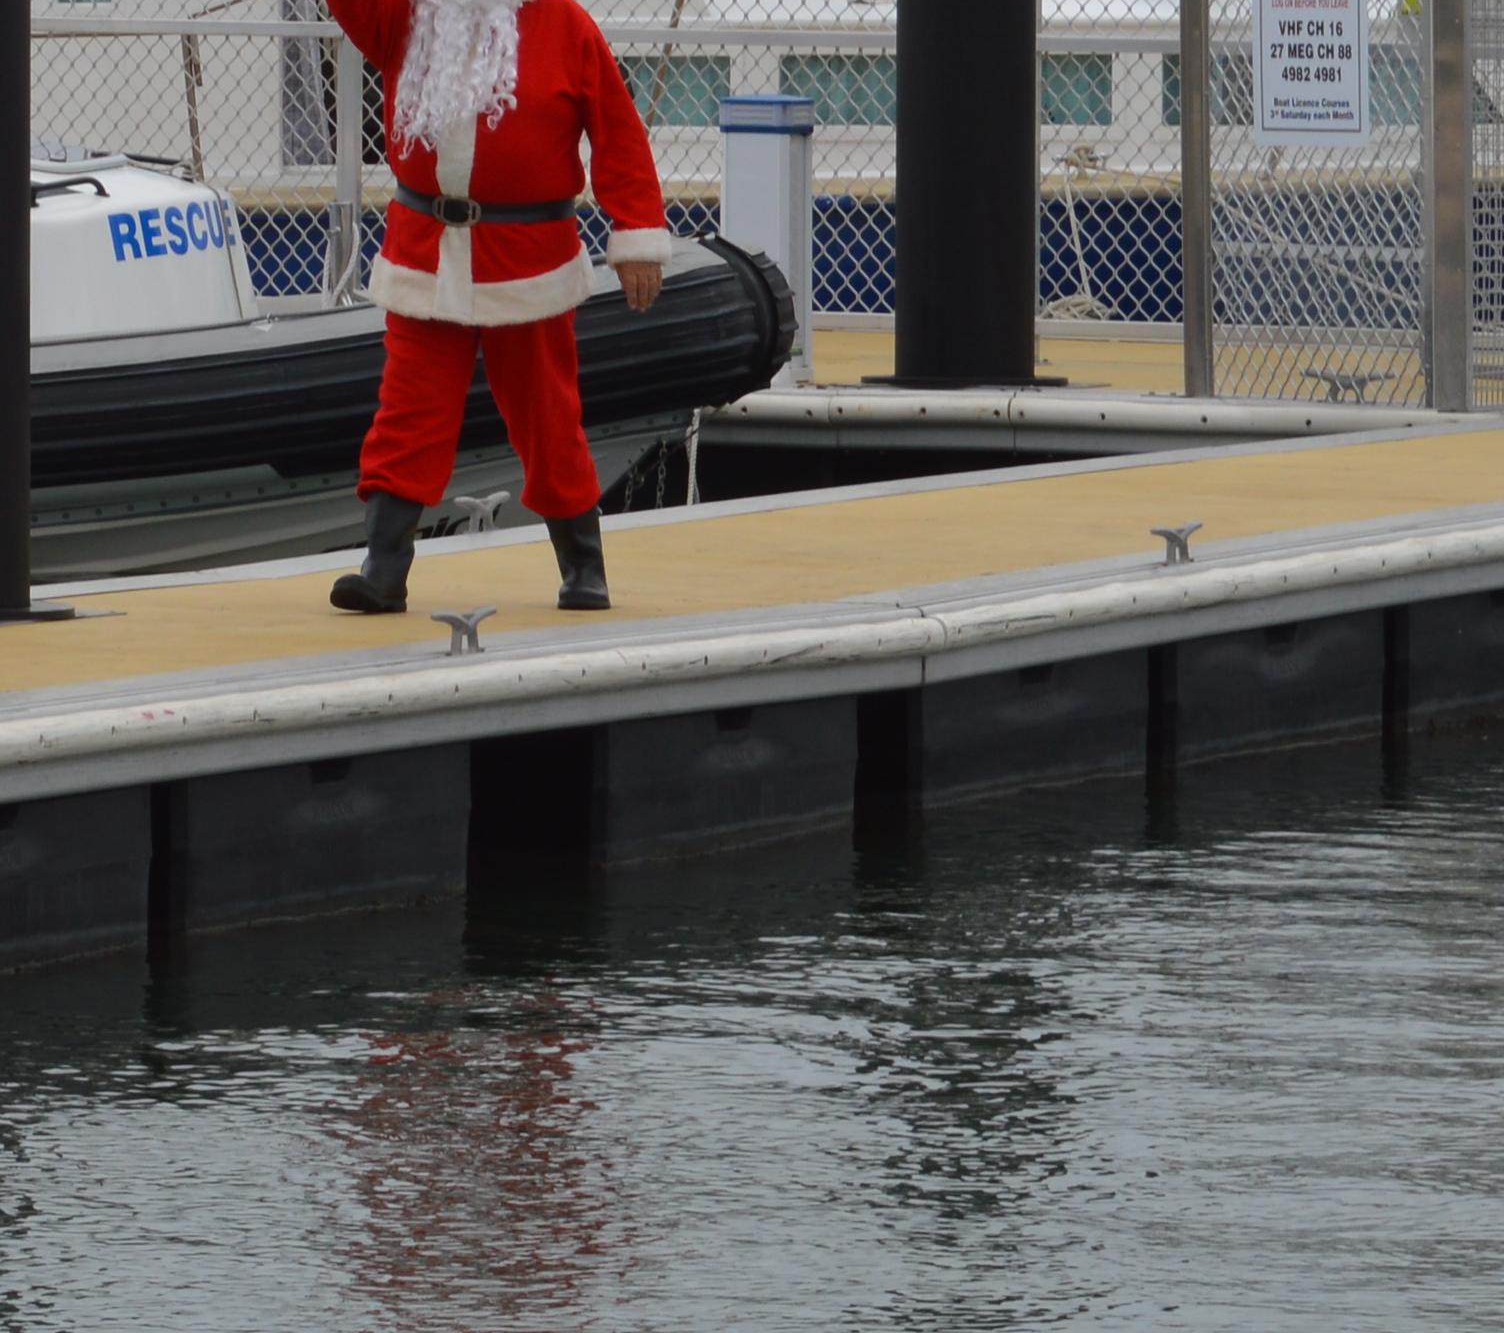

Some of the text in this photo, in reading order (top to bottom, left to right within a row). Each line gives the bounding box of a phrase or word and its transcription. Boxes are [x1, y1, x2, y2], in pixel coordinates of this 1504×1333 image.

[1278, 20, 1343, 37] VHF CH 16
[1270, 43, 1352, 60] 27 MEG CH 88
[1281, 66, 1341, 82] 4982 4981
[1273, 97, 1350, 108] Boat Licence Courses
[1280, 110, 1311, 121] Saturday
[1313, 110, 1330, 120] each
[1332, 110, 1354, 120] Month
[107, 198, 236, 263] RESCUE
